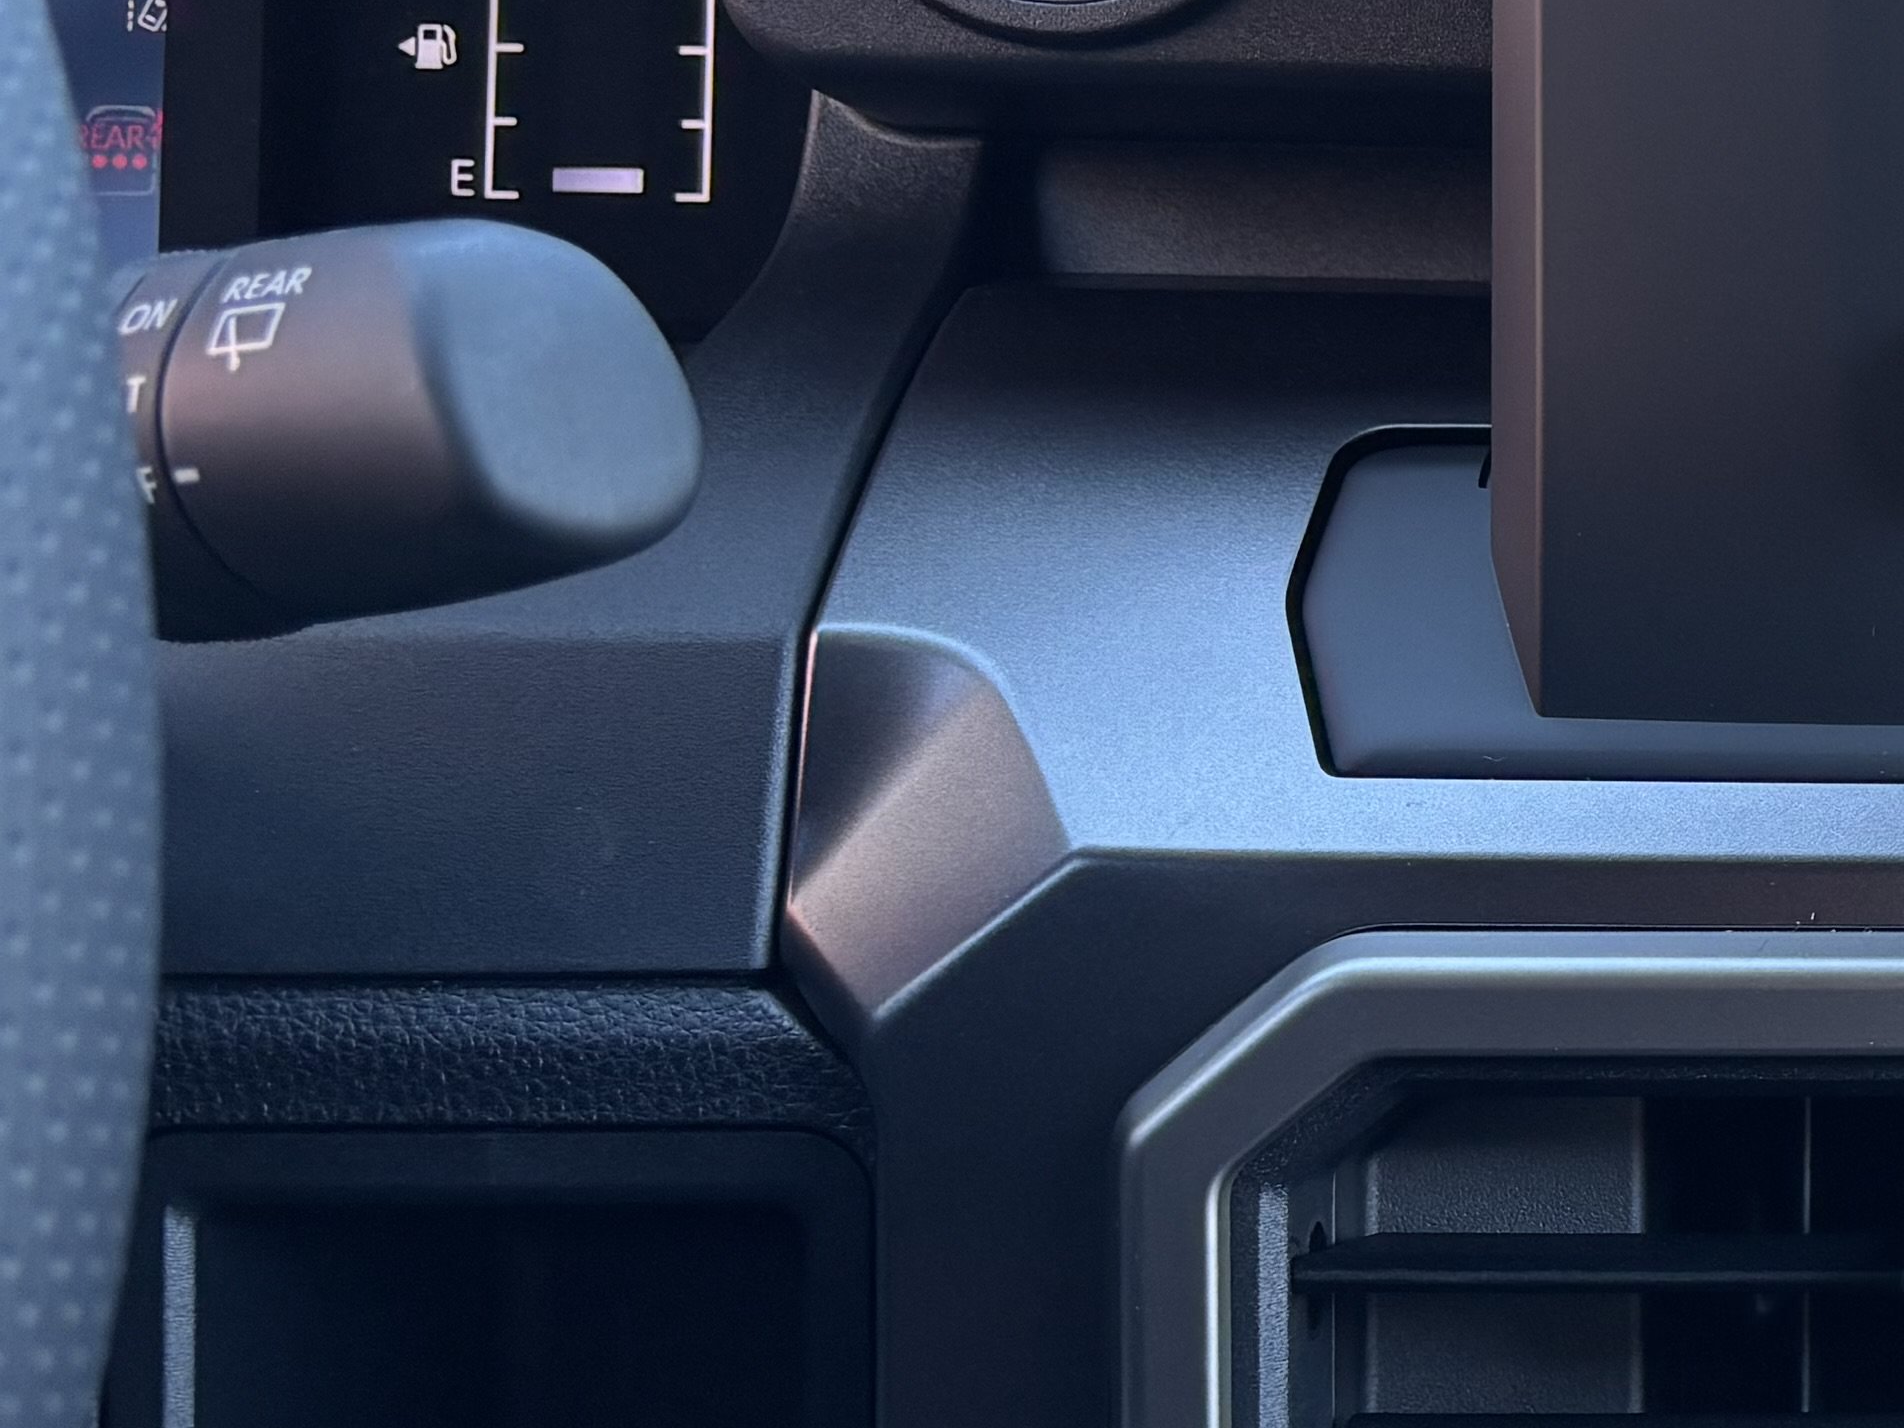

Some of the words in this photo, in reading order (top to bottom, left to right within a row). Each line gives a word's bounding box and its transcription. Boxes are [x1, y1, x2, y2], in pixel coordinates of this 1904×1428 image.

[451, 158, 476, 197] E
[220, 266, 312, 303] REAR
[117, 298, 178, 336] ON
